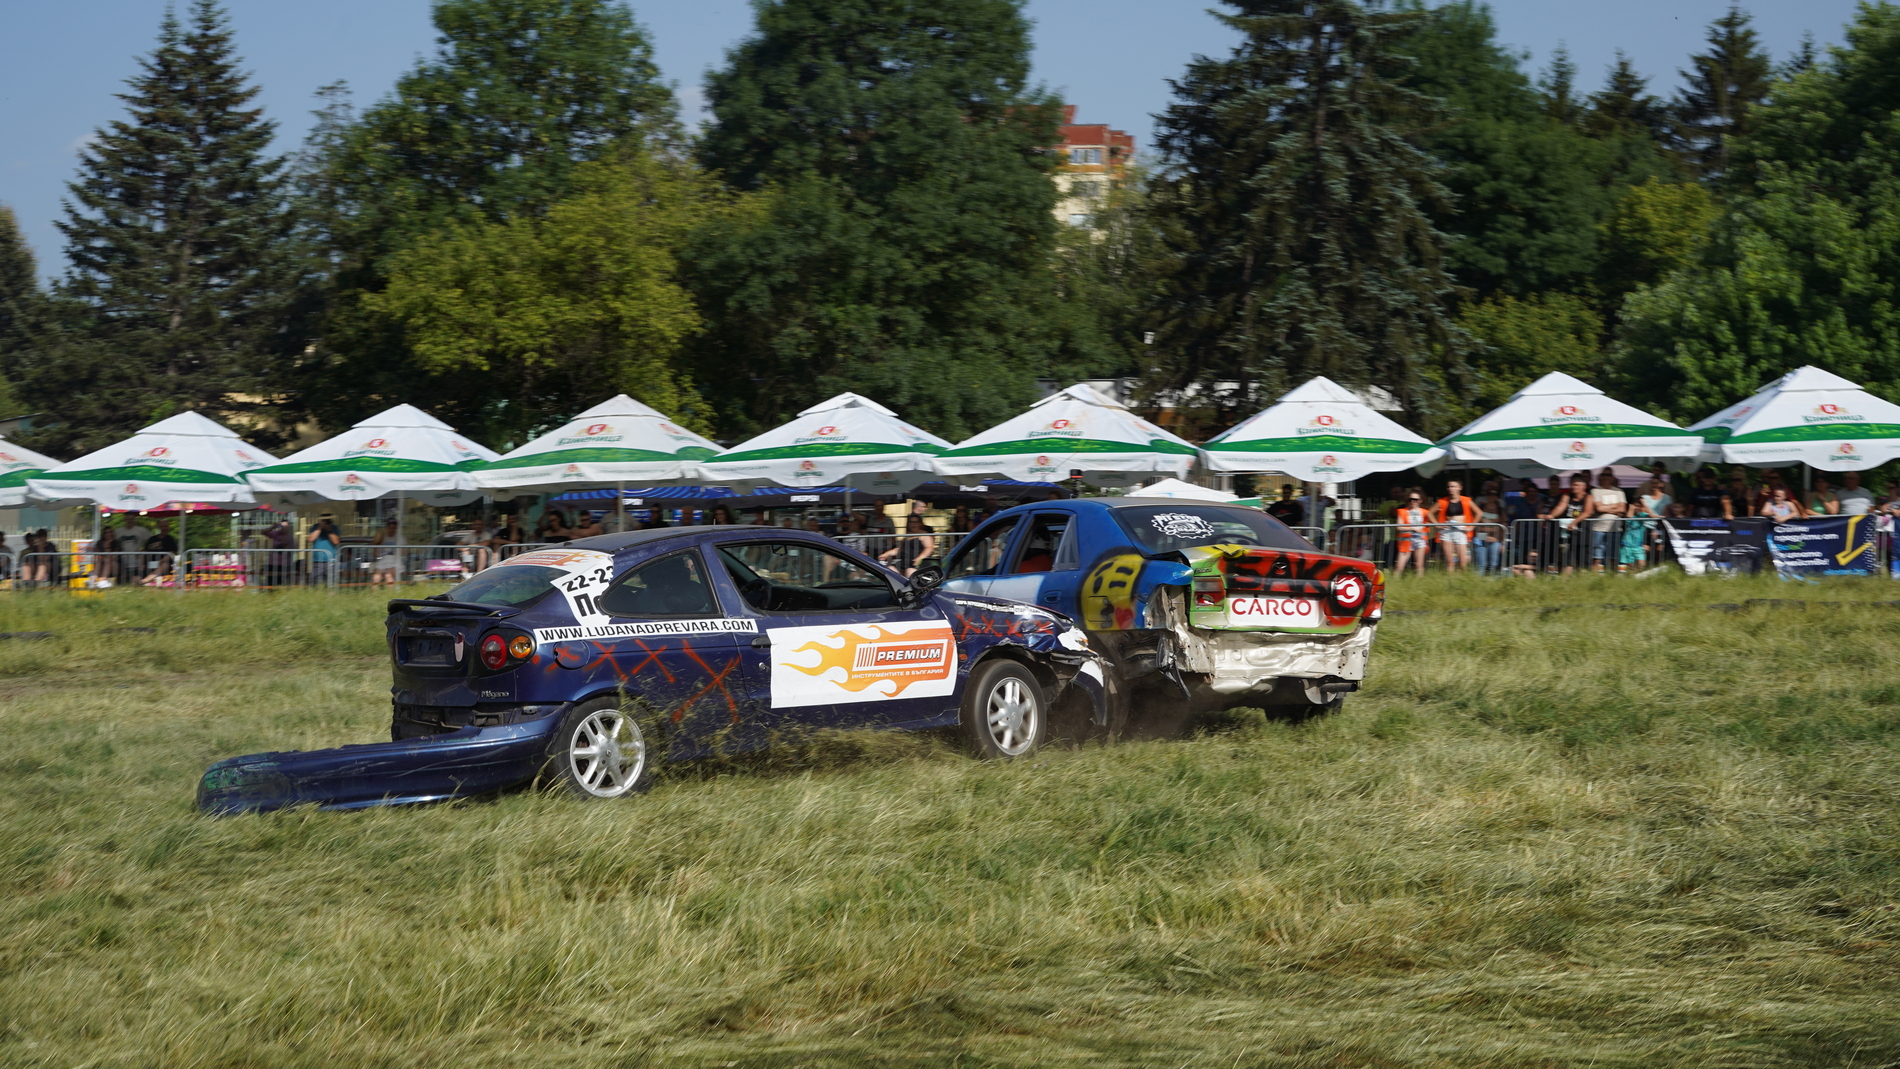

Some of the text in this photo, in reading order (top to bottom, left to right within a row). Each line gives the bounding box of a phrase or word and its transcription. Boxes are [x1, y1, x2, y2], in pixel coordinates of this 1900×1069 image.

[1231, 598, 1312, 616] CARCO
[539, 620, 754, 641] WWW.LUDANADPREVARA.COM
[876, 648, 941, 662] PREMIUM
[852, 671, 904, 679] ИНСТРУМЕНТИТЕ
[911, 668, 944, 676] БЪЛГАРИЯ
